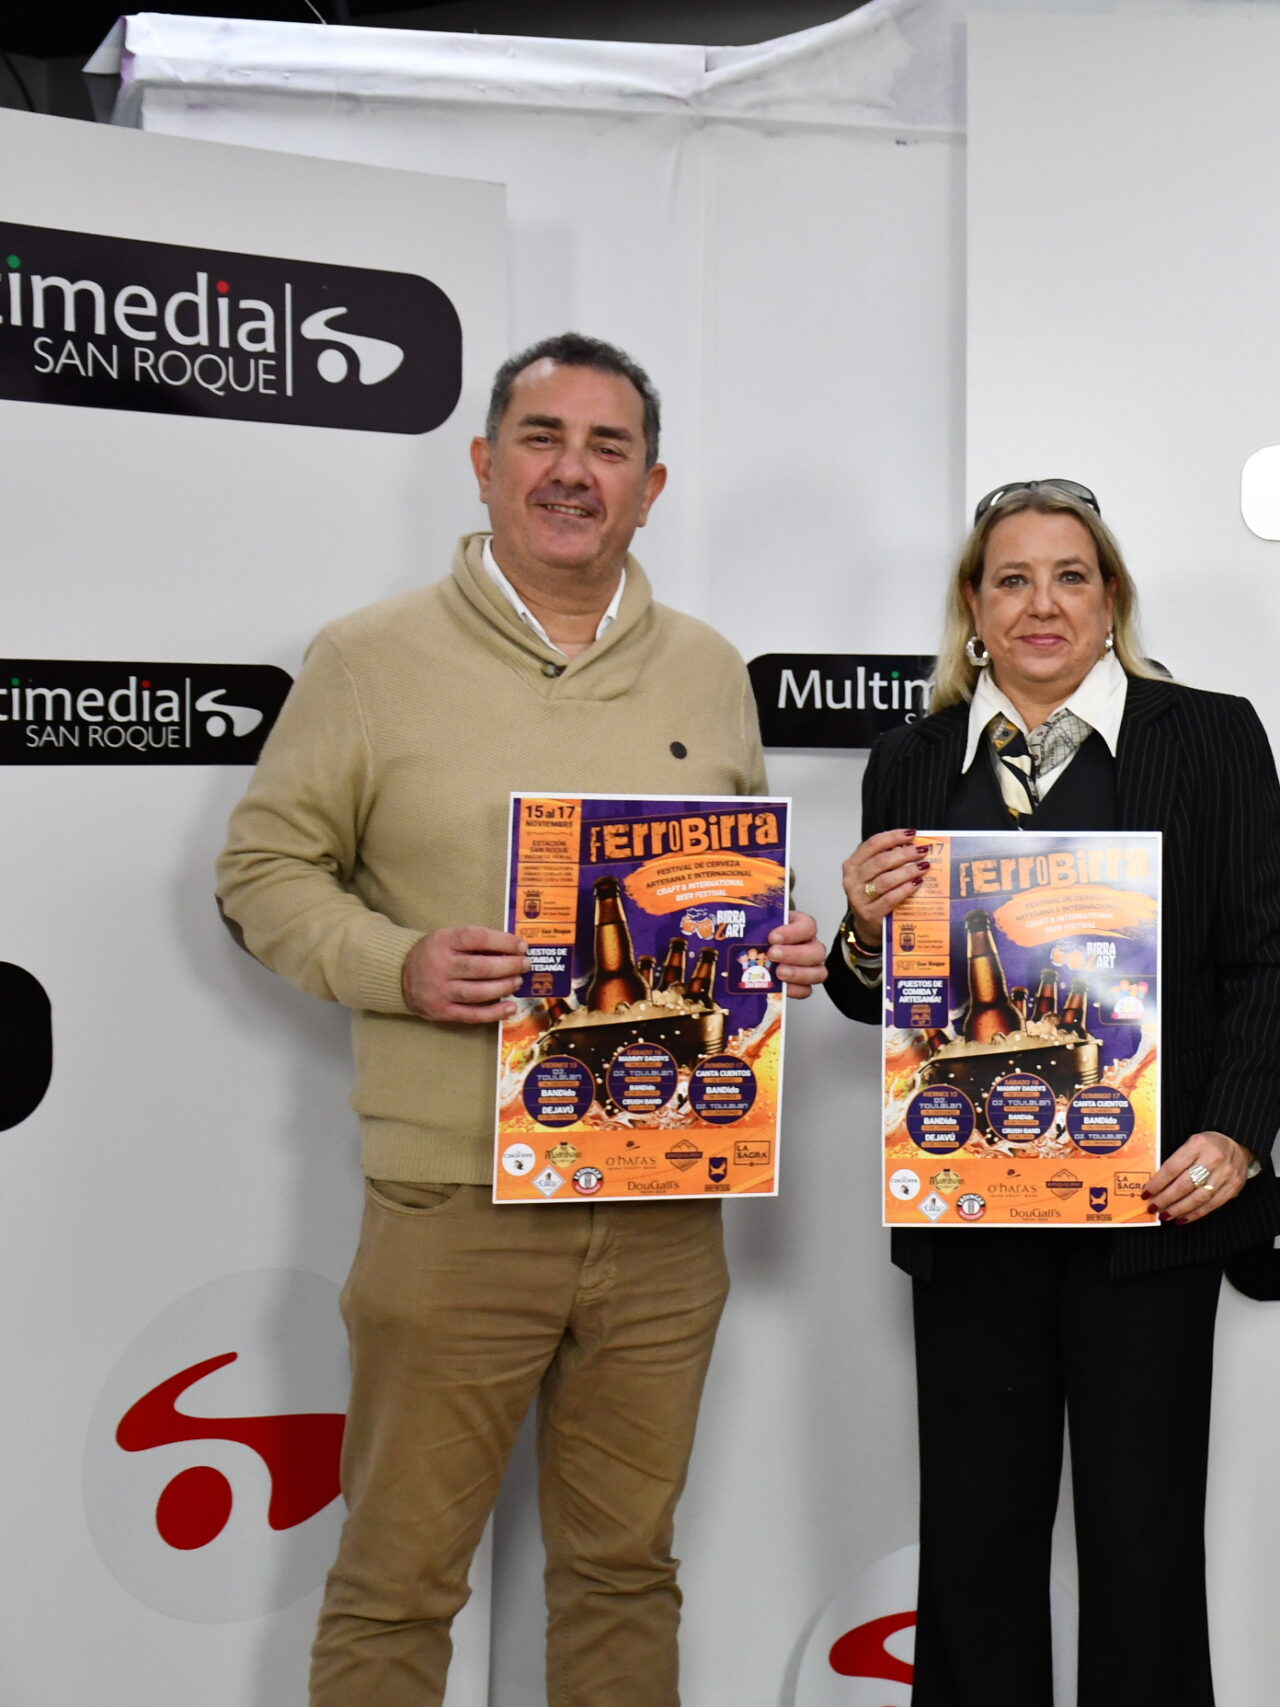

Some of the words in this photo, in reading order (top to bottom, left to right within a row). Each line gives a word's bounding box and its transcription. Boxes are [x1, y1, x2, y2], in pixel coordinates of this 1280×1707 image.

[0, 255, 277, 354] imedia
[33, 336, 119, 380] SAN
[134, 347, 278, 396] ROQUE
[26, 725, 80, 748] SAN
[88, 725, 181, 751] ROQUE
[525, 804, 543, 818] 15
[545, 808, 555, 818] al
[557, 805, 575, 818] 17
[657, 864, 692, 876] FESTIVAL
[705, 860, 740, 868] CERVEZA
[646, 876, 686, 889] ARTESANA
[693, 870, 753, 878] INTERNACIONAL
[716, 909, 746, 924] BIRRA
[725, 924, 744, 938] ART
[1086, 941, 1116, 956] BIRRA
[1095, 955, 1115, 969] ART
[902, 987, 932, 995] COMIDA
[931, 987, 938, 995] Y
[705, 1086, 739, 1094] BANDido
[541, 1104, 574, 1114] DEJAVÚ
[1083, 1116, 1117, 1124] BANDido
[924, 1132, 955, 1141] DEJAVÚ
[736, 1151, 767, 1159] SAGRA
